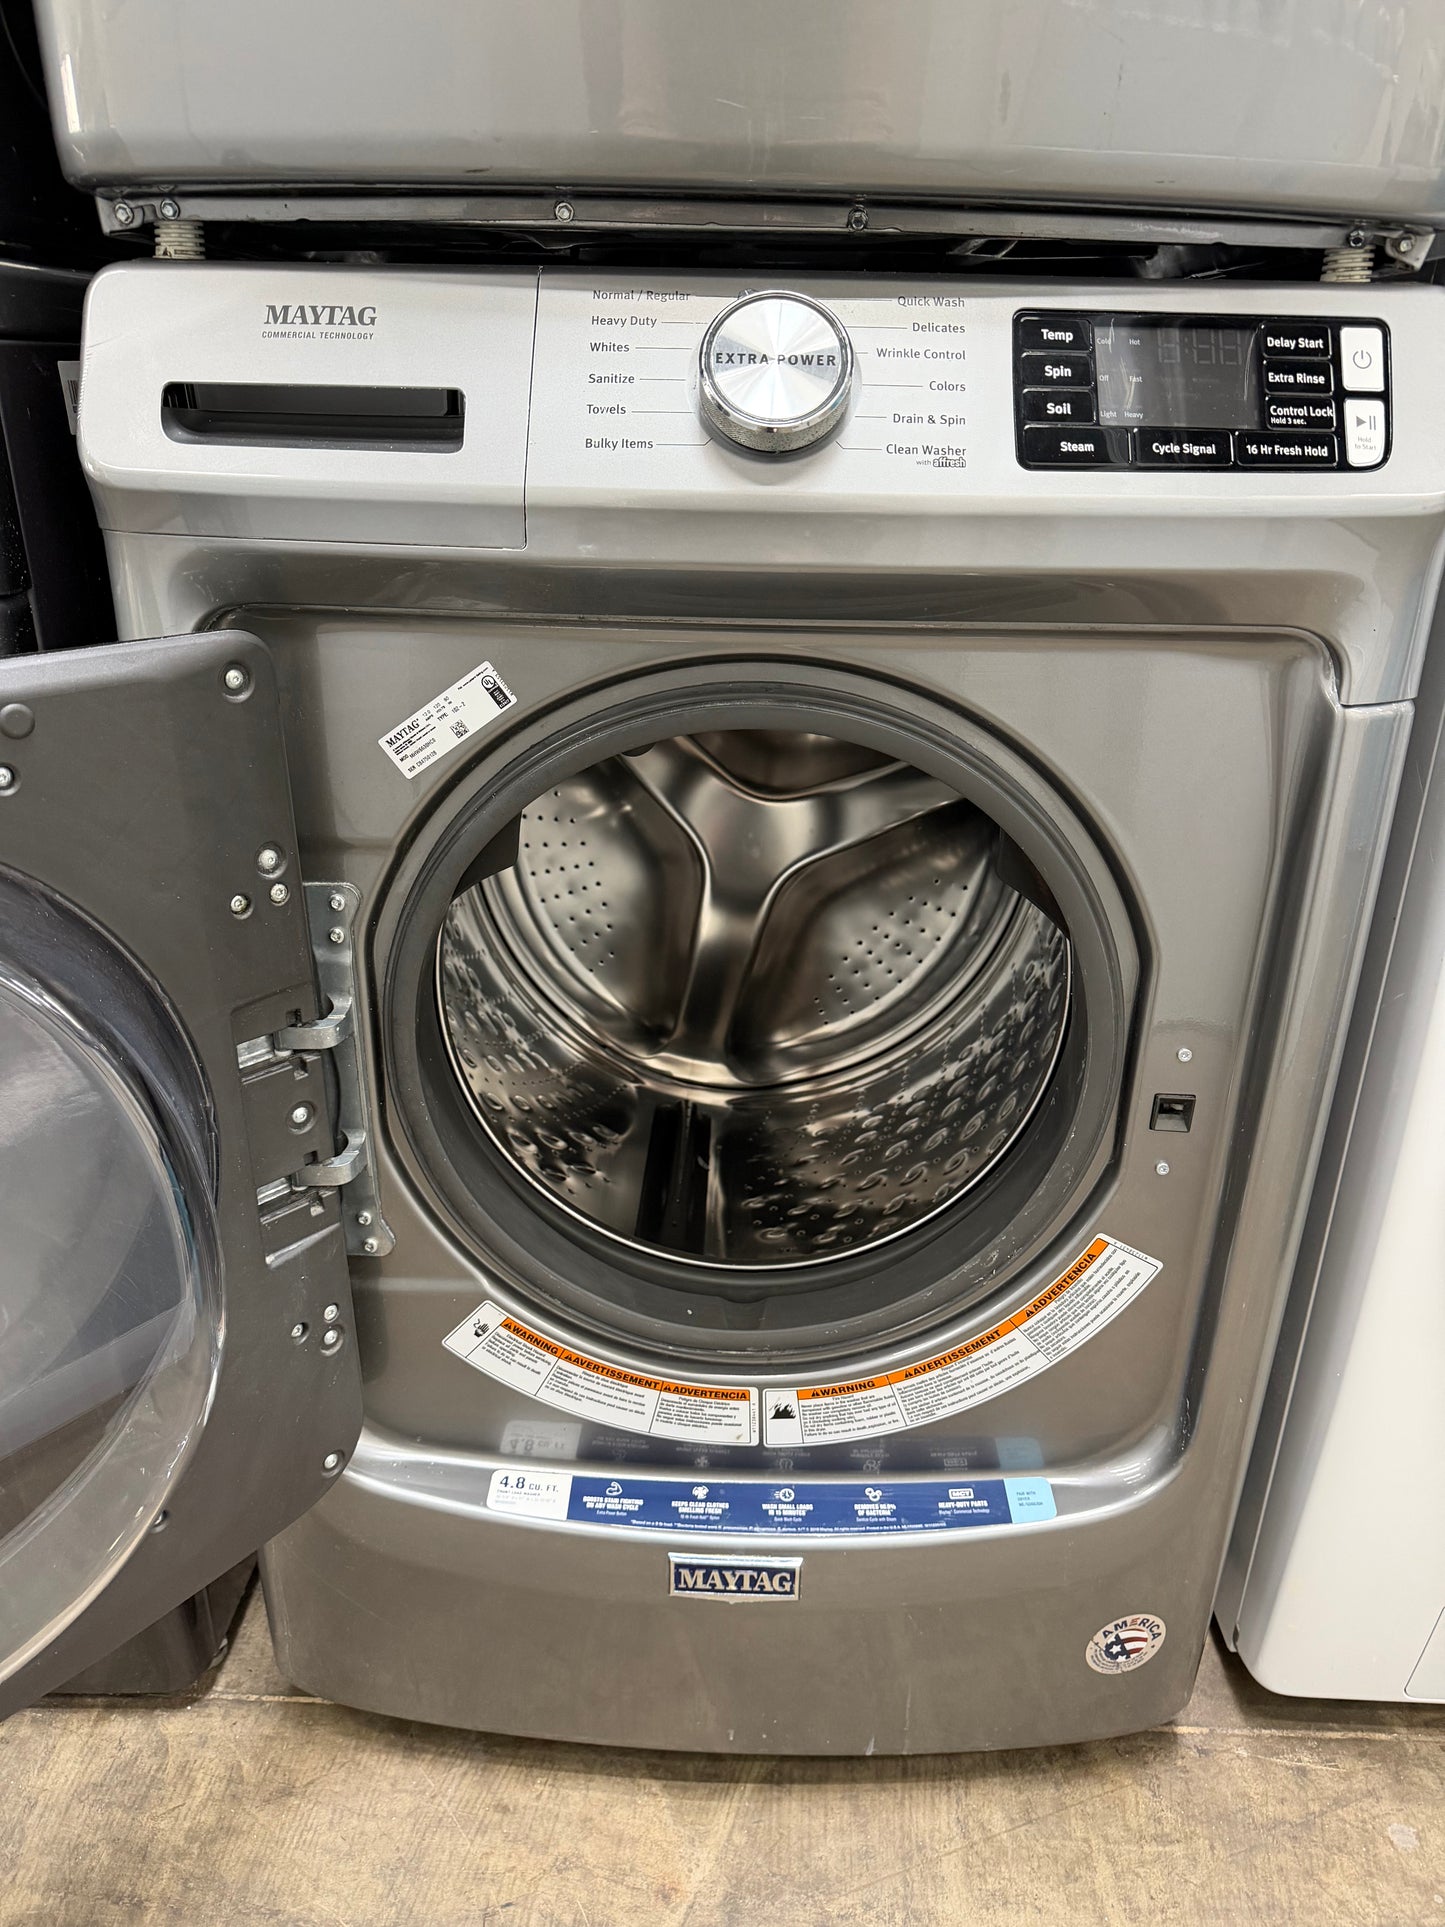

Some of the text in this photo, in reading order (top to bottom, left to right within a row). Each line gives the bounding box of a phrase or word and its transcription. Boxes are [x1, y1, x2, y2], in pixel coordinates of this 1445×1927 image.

[592, 290, 634, 301] Normal
[647, 290, 691, 302] Regular
[897, 296, 965, 308] Quick Wash
[264, 305, 377, 326] MAYTAG
[591, 315, 657, 328] Heavy Duty
[912, 322, 966, 333] Delicates
[262, 331, 374, 340] COMMERCIAL TECHNOLOGY
[1041, 329, 1074, 343] Temp
[590, 342, 630, 352] Whites
[1267, 337, 1324, 350] Delay Start
[716, 352, 836, 366] EXTRA POWER
[876, 348, 966, 360] Wrinkle Control
[588, 373, 635, 384] Sanitize
[1044, 365, 1072, 379] Spin
[1268, 372, 1325, 384] Extra Rinse
[929, 381, 966, 392] Colors
[587, 404, 626, 415] Towels
[1046, 403, 1071, 415] Soil
[1124, 411, 1144, 419] Heavy
[1270, 405, 1333, 417] Control Lock
[893, 413, 966, 427] Drain & Spin
[585, 438, 654, 450] Bulky Items
[886, 443, 966, 456] Clean Washer
[1060, 441, 1095, 452] Steam
[1152, 442, 1216, 455] Cycle Signal
[1246, 444, 1328, 457] 16 Hr Fresh Hold
[932, 456, 966, 468] affresh
[1032, 1251, 1097, 1311] ADVERTENCIA
[511, 1325, 559, 1355] WARNING
[912, 1329, 1002, 1377] AVERTISSEMENT
[571, 1355, 660, 1391] AVERTISSEMENT
[672, 1385, 747, 1400] ADVERTENCIA
[816, 1379, 876, 1396] WARNING
[500, 1475, 559, 1492] 4.8 CU. FT.
[678, 1568, 792, 1593] MAYTAG
[1102, 1617, 1162, 1641] AMERICA
